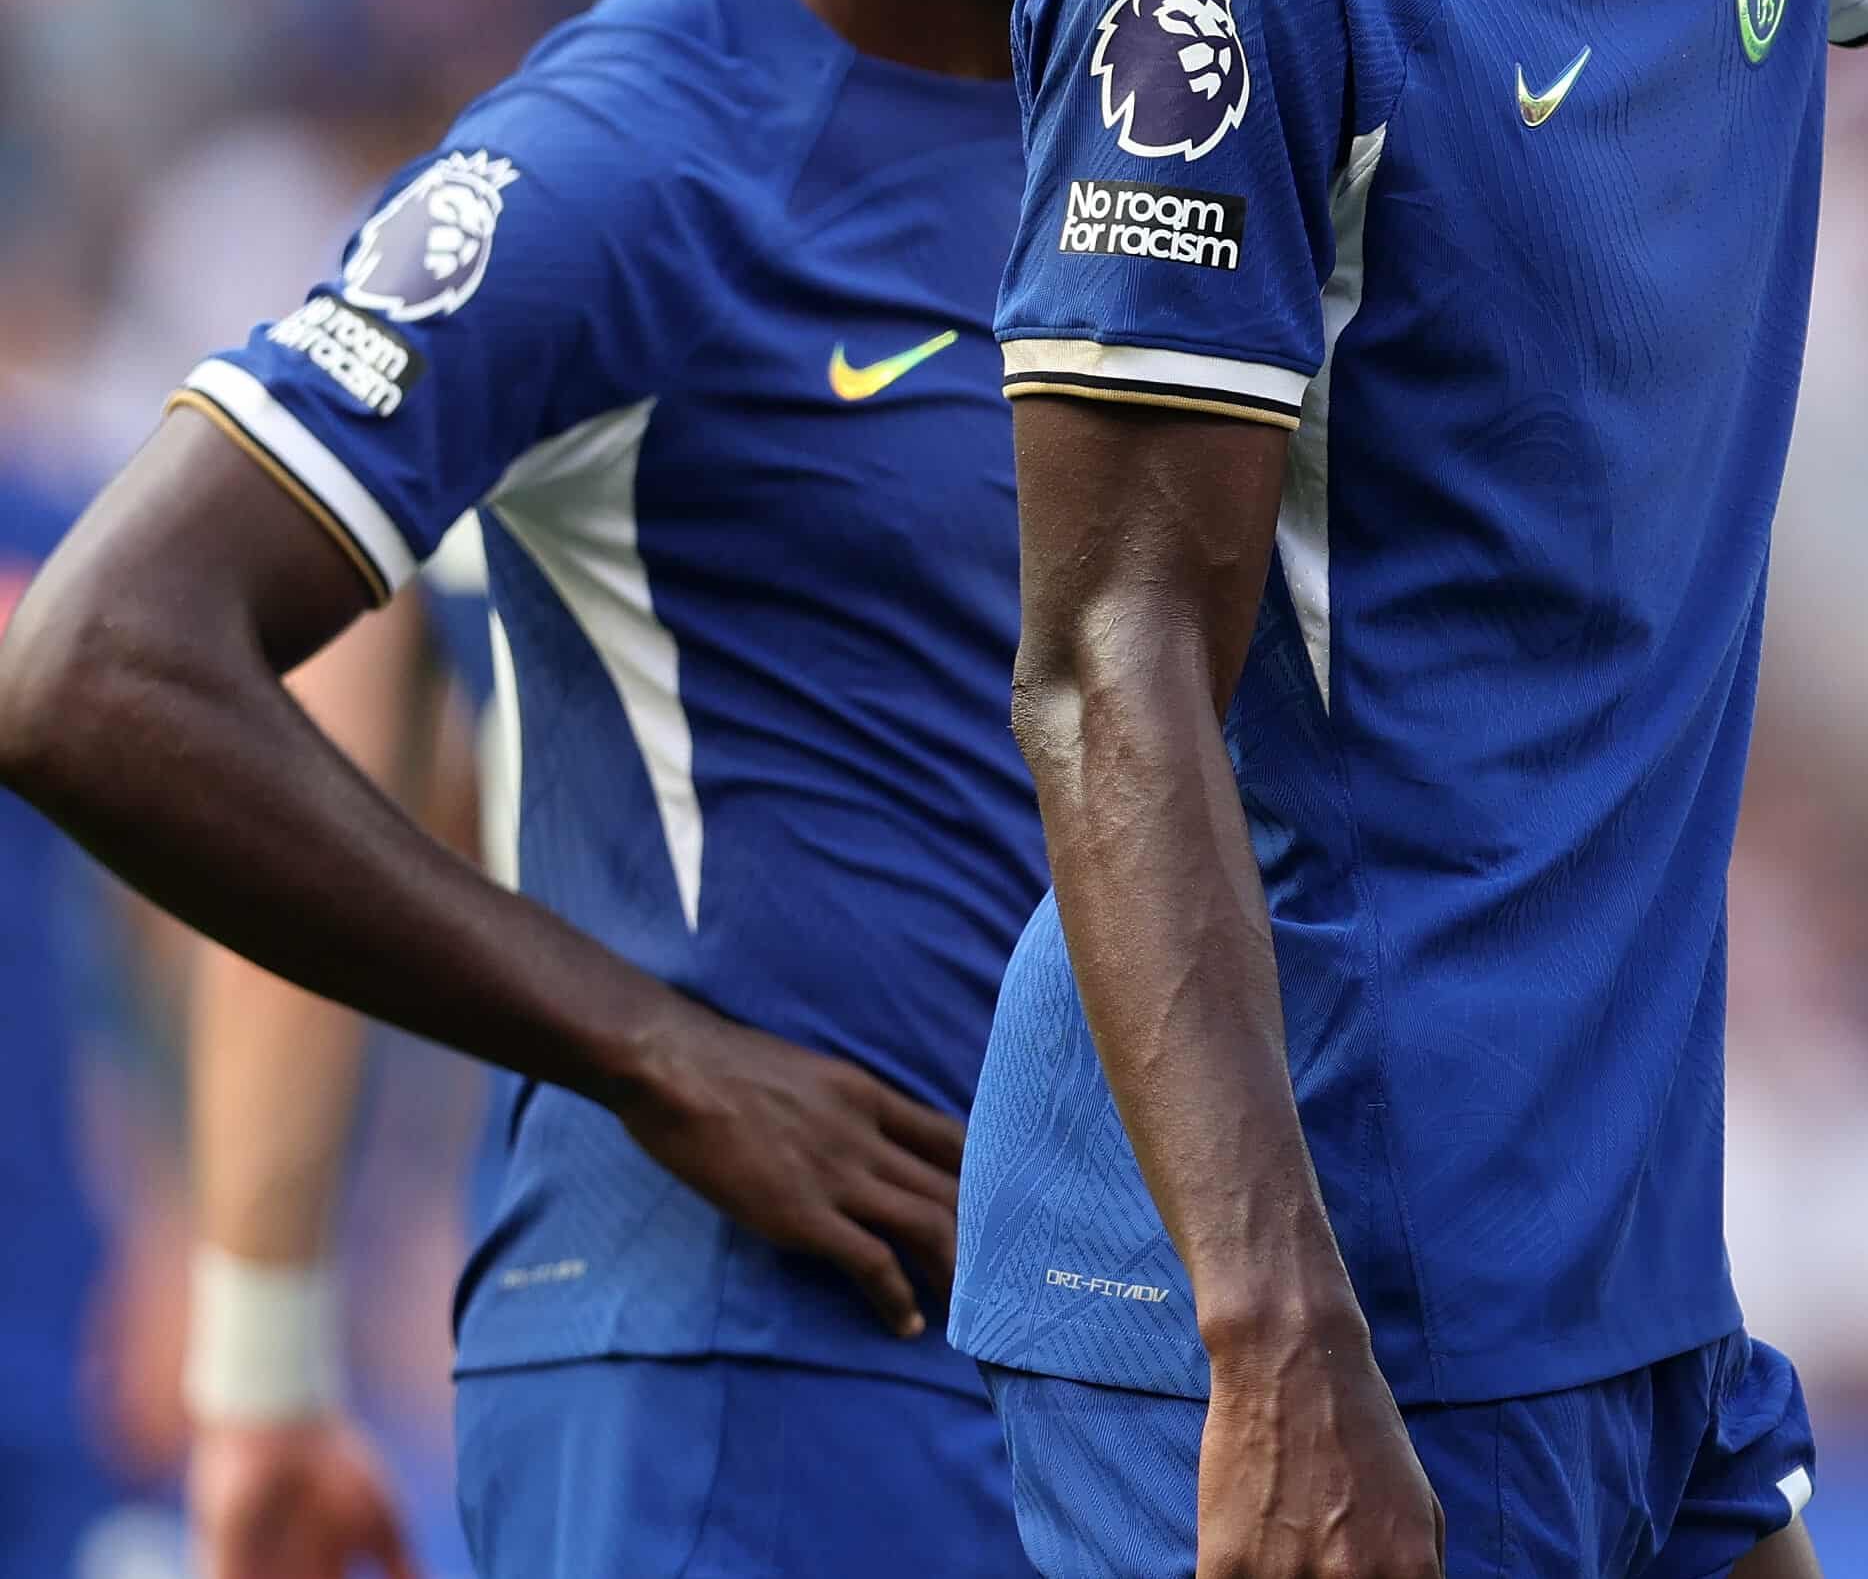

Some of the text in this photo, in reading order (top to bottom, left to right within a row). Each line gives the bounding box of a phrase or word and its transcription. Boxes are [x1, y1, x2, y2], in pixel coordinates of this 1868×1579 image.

[1067, 181, 1225, 233] No room
[1060, 216, 1239, 270] for racism
